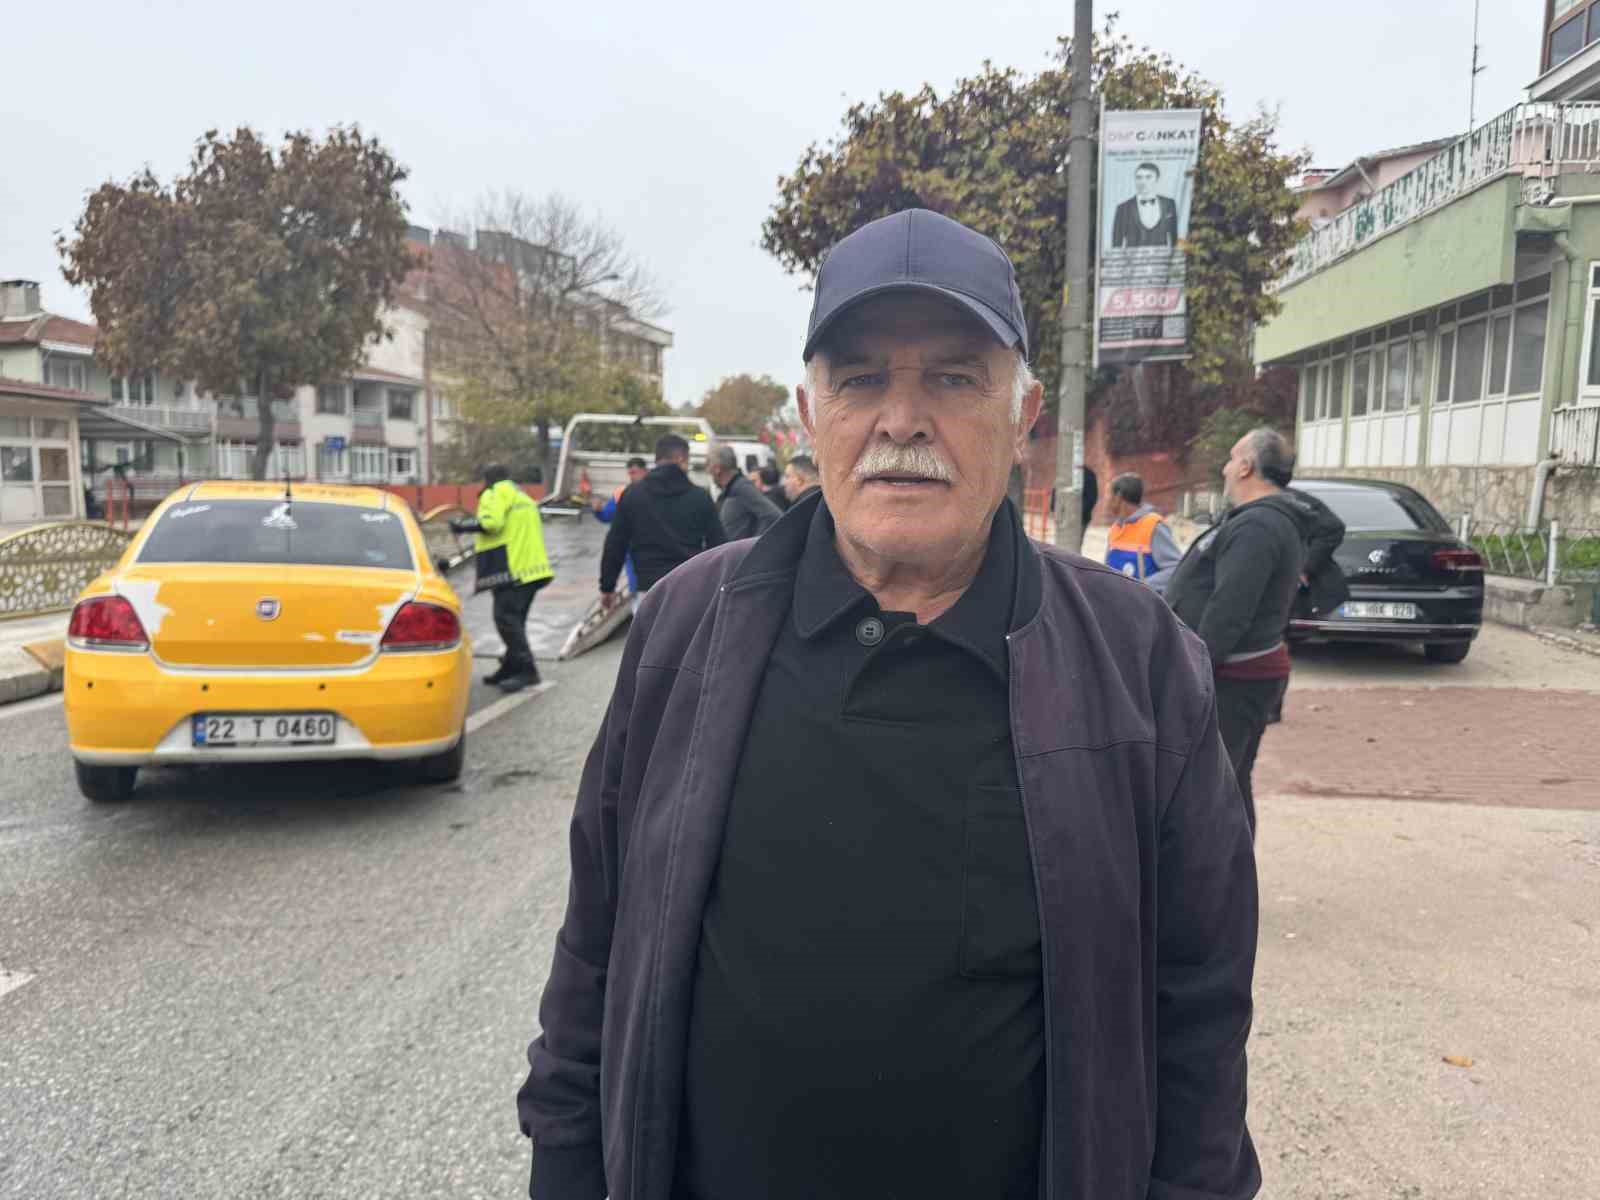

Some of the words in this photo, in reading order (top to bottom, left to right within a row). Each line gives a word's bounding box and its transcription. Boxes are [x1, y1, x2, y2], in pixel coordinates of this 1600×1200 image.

[1135, 129, 1196, 142] CANKAT
[208, 719, 235, 739] 22
[253, 718, 265, 738] T
[276, 717, 331, 738] 0460
